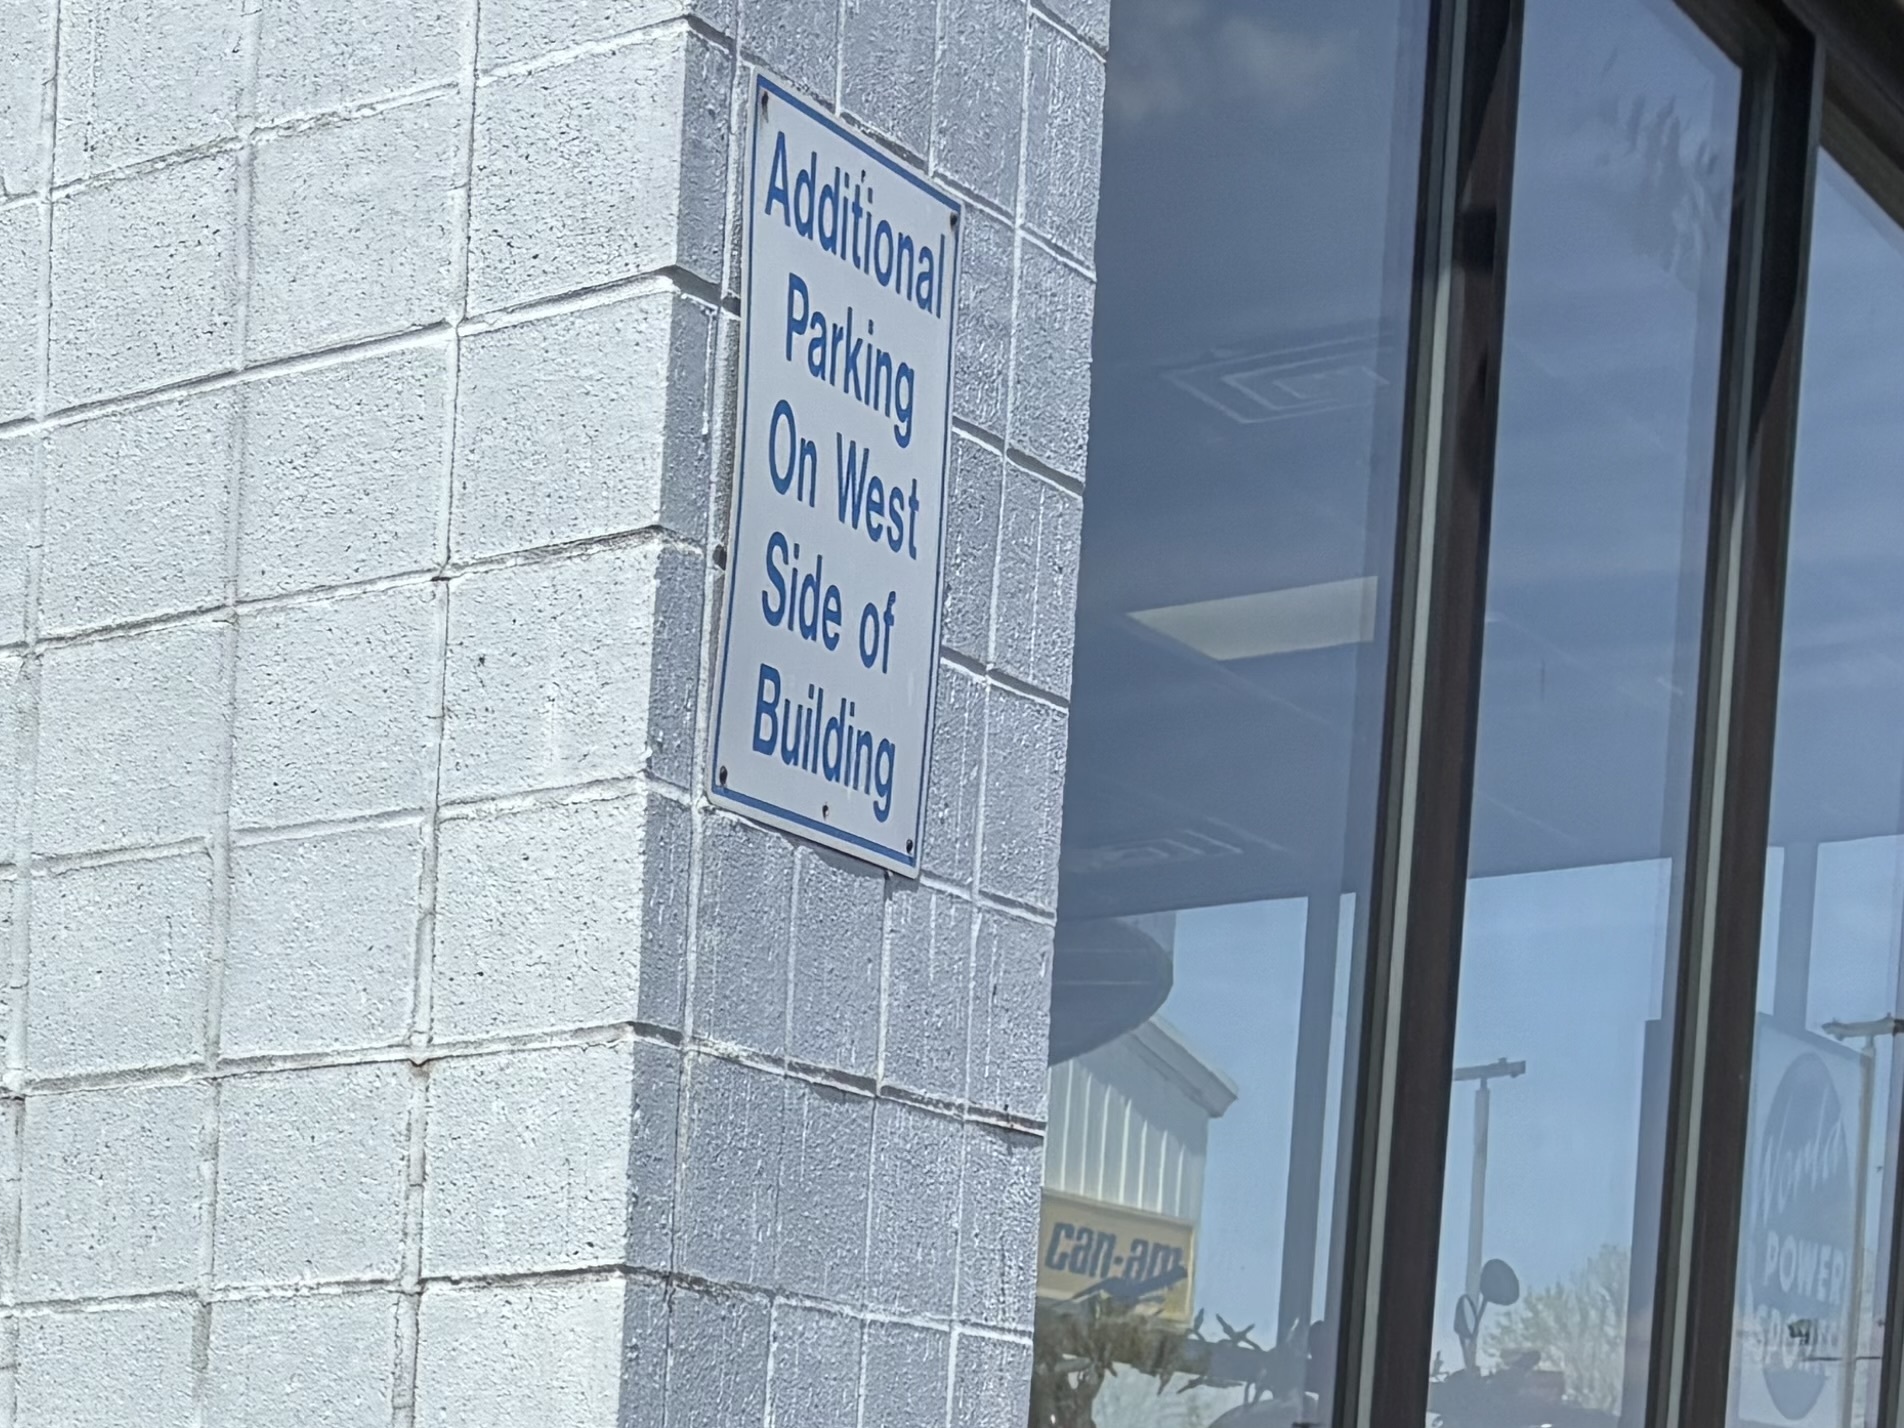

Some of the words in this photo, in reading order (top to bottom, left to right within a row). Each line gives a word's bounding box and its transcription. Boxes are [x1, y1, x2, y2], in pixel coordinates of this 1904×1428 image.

[764, 131, 946, 319] Additional
[786, 272, 916, 449] Parking
[767, 398, 817, 509] On
[836, 431, 919, 561] West
[761, 530, 842, 652] Side
[859, 589, 897, 675] of
[752, 663, 897, 824] Building
[1044, 1221, 1186, 1282] can-am
[1764, 1230, 1846, 1306] POWER
